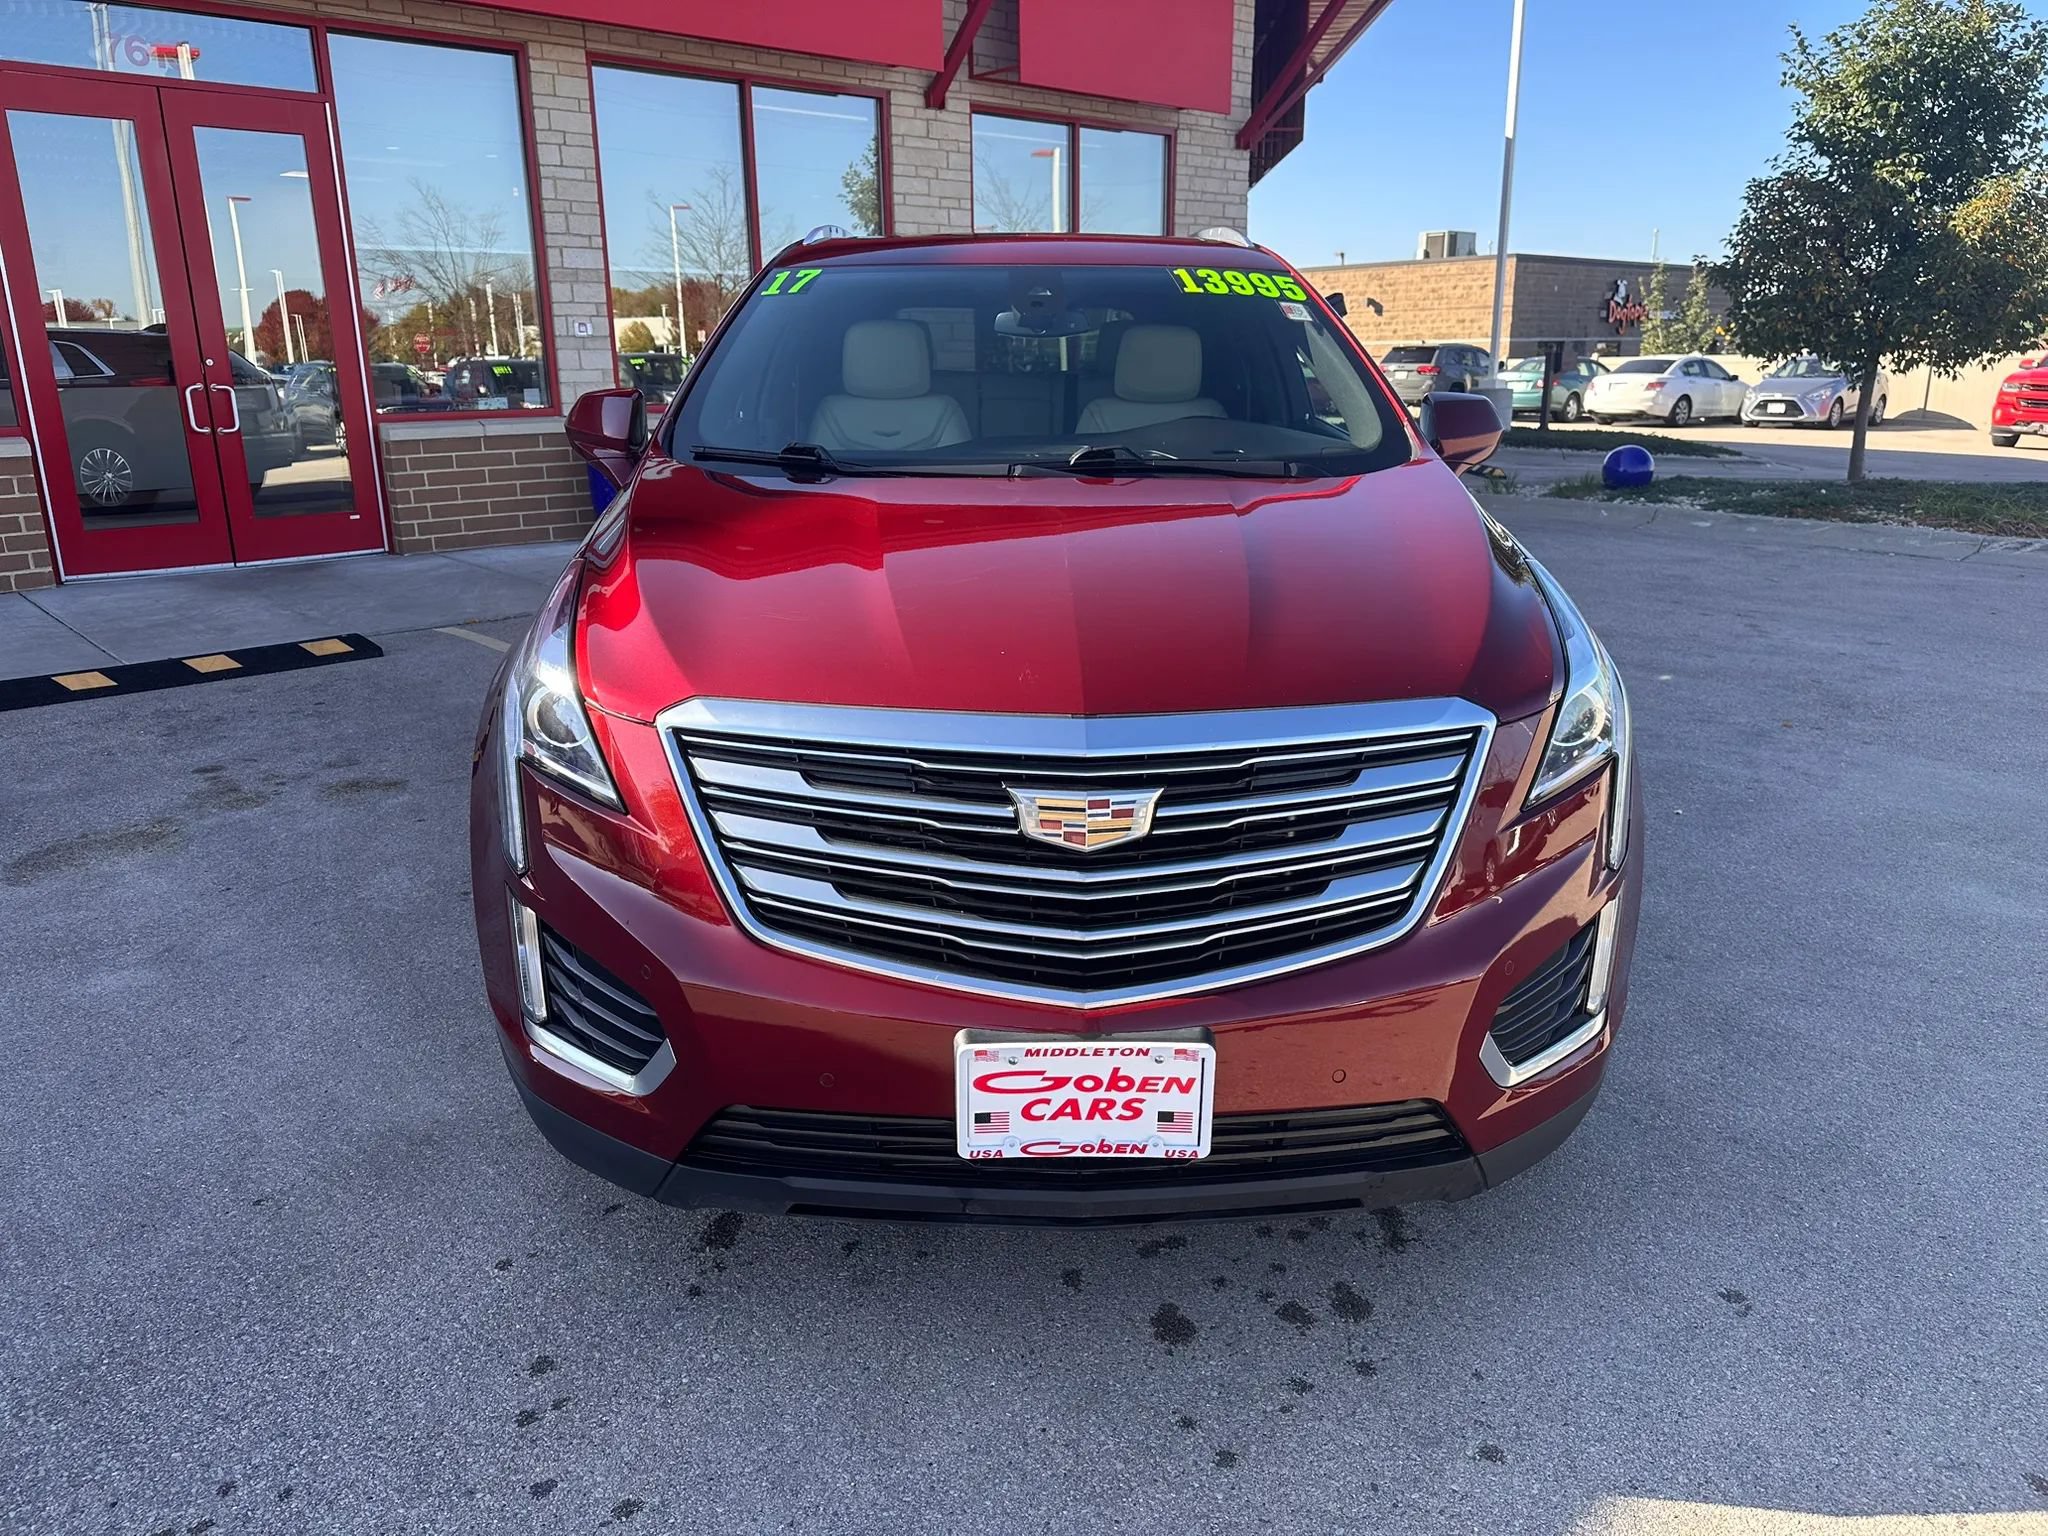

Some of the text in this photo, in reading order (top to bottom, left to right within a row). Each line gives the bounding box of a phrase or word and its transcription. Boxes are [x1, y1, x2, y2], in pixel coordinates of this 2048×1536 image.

[760, 268, 823, 296] 17
[1173, 268, 1307, 301] 13995
[1024, 1047, 1151, 1058] MIDDLETON
[1020, 1098, 1147, 1121] CARS
[969, 1149, 1004, 1159] USA
[1164, 1149, 1199, 1159] USA
